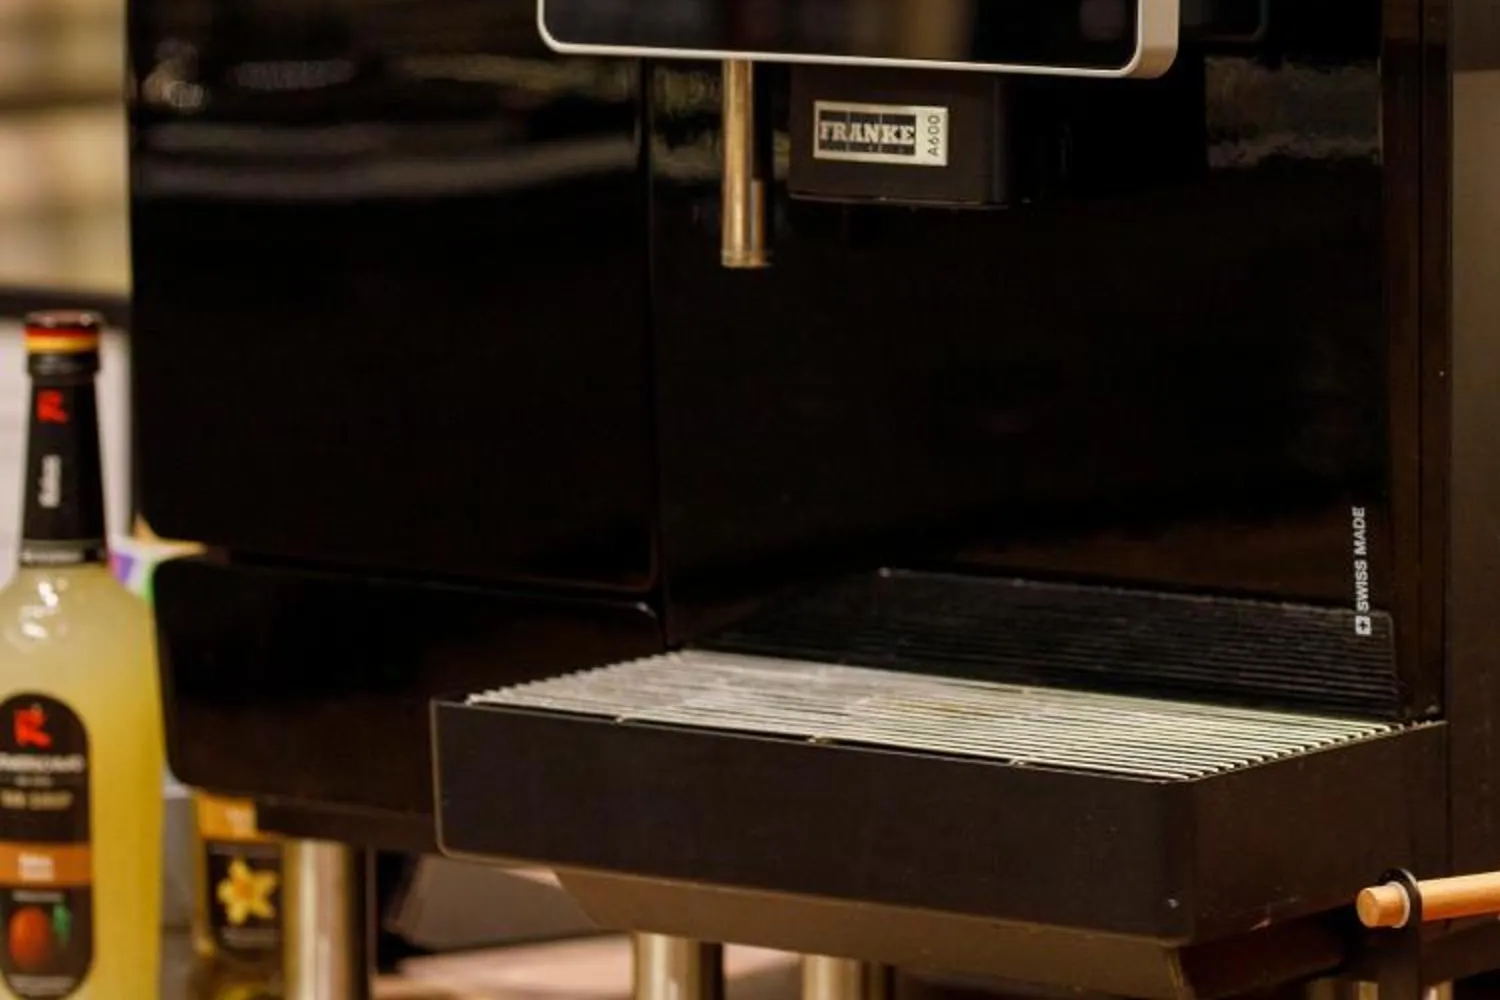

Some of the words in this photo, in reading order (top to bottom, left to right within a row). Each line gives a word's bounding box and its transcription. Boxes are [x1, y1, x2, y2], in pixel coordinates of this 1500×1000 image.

[819, 120, 915, 144] FRANKE
[927, 114, 941, 157] A600
[1351, 506, 1367, 555] MADE
[1354, 559, 1369, 614] SWISS
